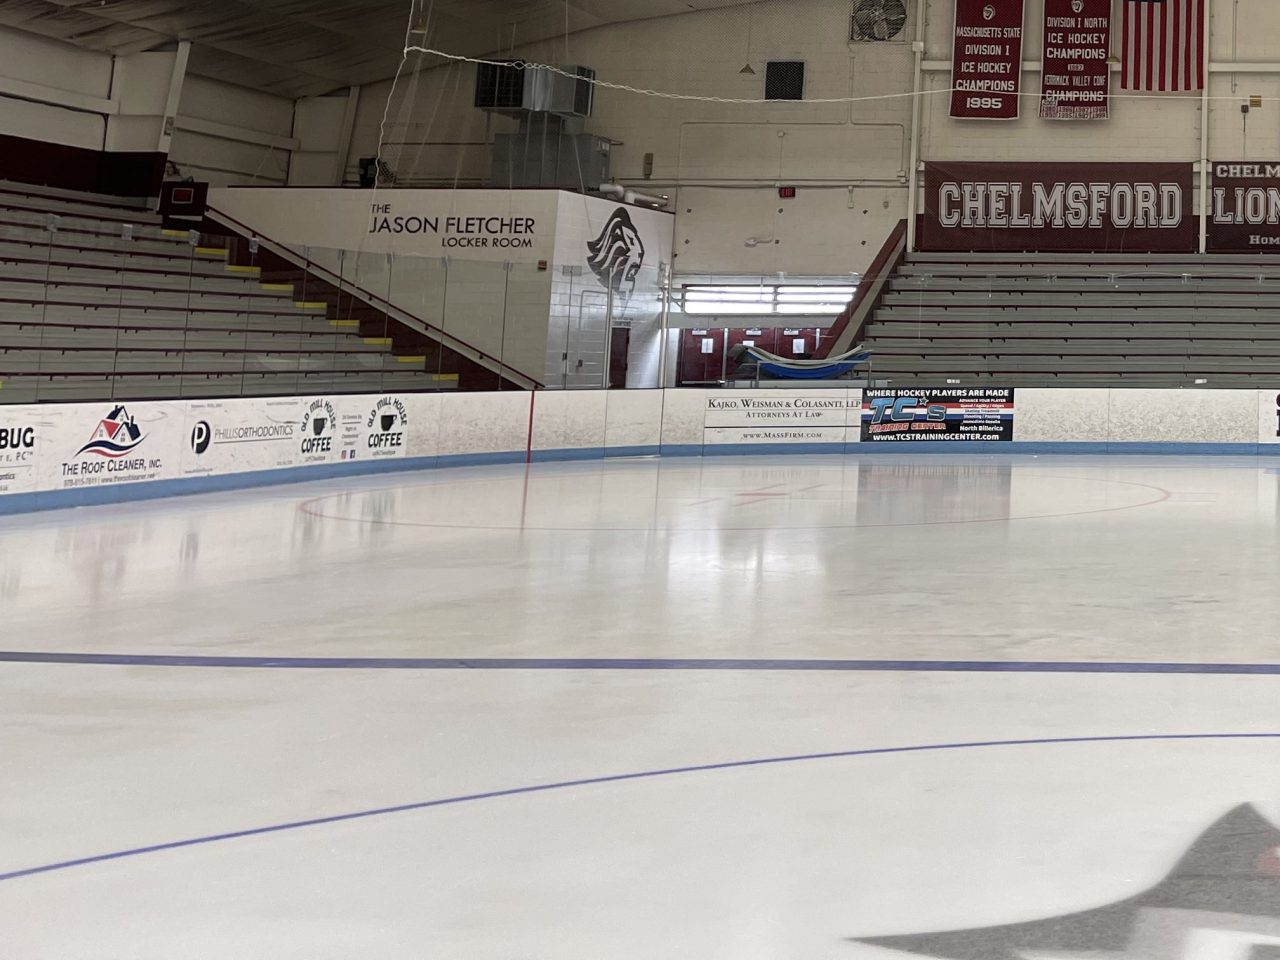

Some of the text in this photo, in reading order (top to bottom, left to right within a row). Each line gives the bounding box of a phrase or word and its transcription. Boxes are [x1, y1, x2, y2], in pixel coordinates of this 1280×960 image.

[1047, 17, 1075, 28] DIVISION
[1084, 18, 1107, 29] NORTH
[1003, 28, 1021, 38] STATE
[1048, 32, 1106, 45] ICE HOCKEY
[965, 44, 1001, 56] DIVISION
[1046, 47, 1106, 60] CHAMPIONS
[961, 62, 1012, 74] ICE HOCKEY
[956, 79, 1015, 92] CHAMPIONS
[1046, 90, 1105, 103] CHAMPIONS
[966, 97, 1003, 109] 1995
[372, 204, 391, 214] THE
[939, 182, 1182, 228] CHELMSFORD
[369, 216, 536, 234] JASON FLETCHER
[442, 237, 532, 248] LOCKER ROOM
[867, 389, 896, 397] WHERE
[897, 389, 930, 397] HOCKEY
[932, 389, 967, 397] PLAYERS
[785, 400, 791, 409] &
[846, 401, 862, 409] LLP
[300, 399, 337, 432] OLD MILL HOUSE
[368, 397, 408, 428] OLD MILL HOUSE
[745, 411, 790, 419] ATTORNEYS
[869, 422, 947, 433] TRAINING CENTER
[368, 432, 403, 448] COFFEE
[873, 433, 1000, 442] www.TCSTRAININGCENTER.com
[301, 436, 332, 454] COFFEE
[62, 458, 162, 477] THE ROOF CLEANER, INC.
